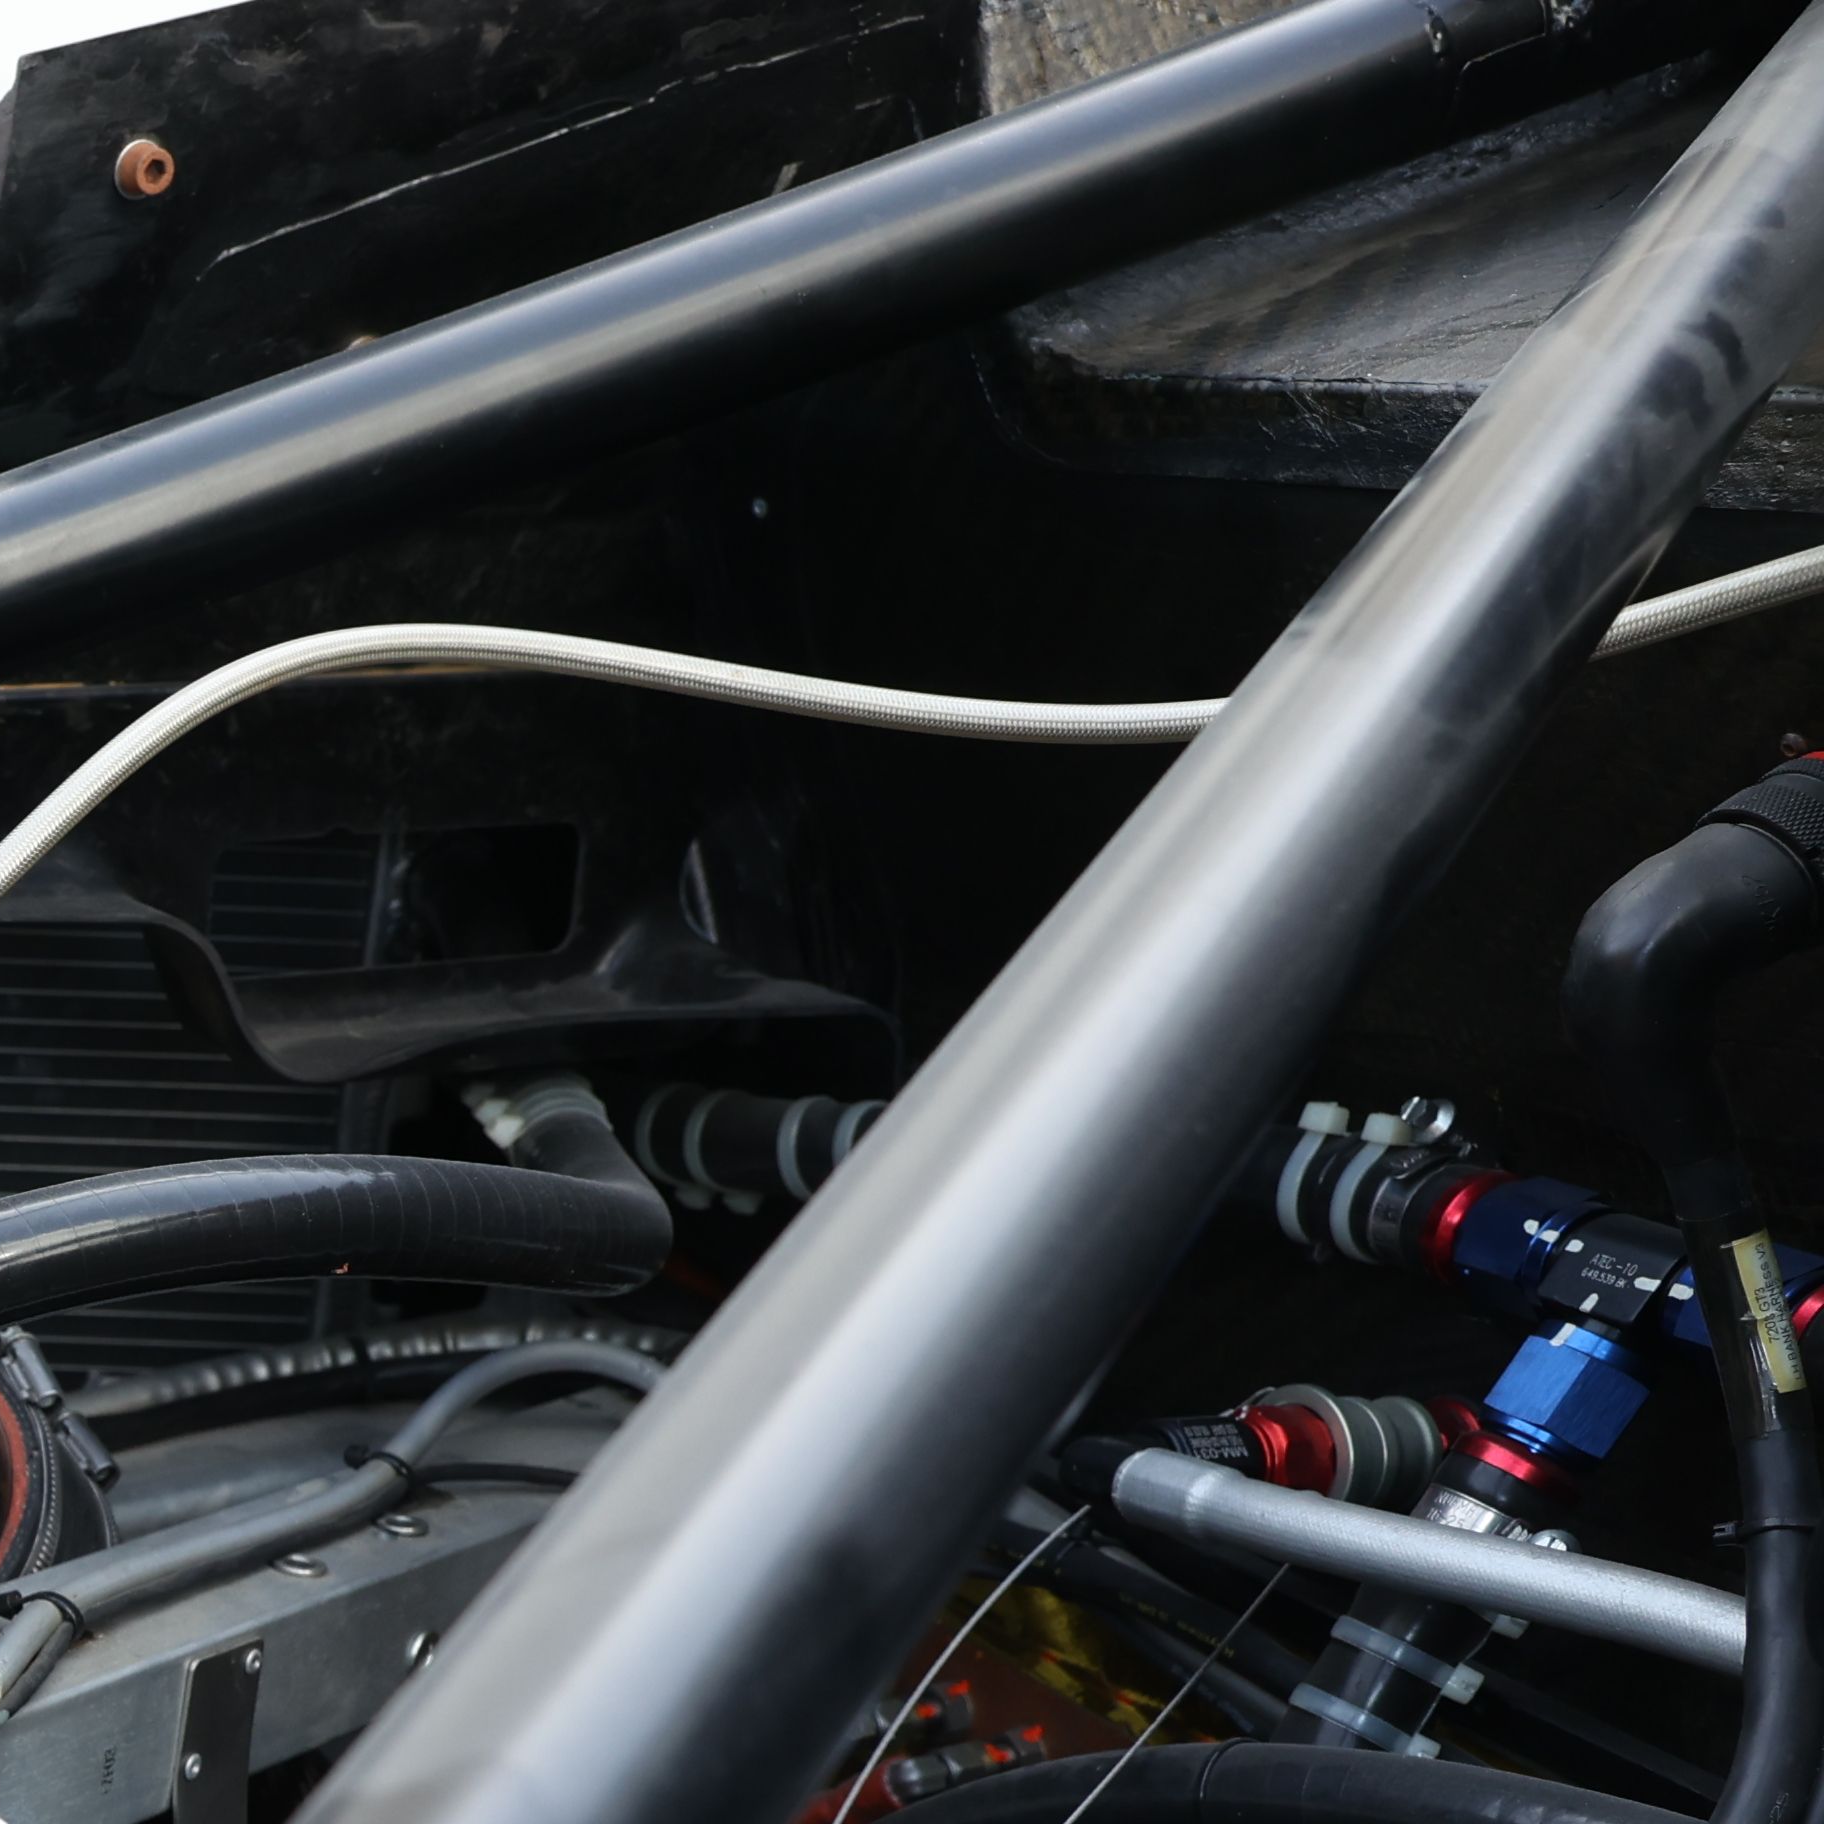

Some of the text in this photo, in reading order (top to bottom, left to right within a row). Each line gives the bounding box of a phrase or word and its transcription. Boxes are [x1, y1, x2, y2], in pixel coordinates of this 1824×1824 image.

[1754, 1286, 1771, 1312] GT3
[1760, 1261, 1788, 1323] HARNESS
[1780, 1326, 1798, 1362] BANK
